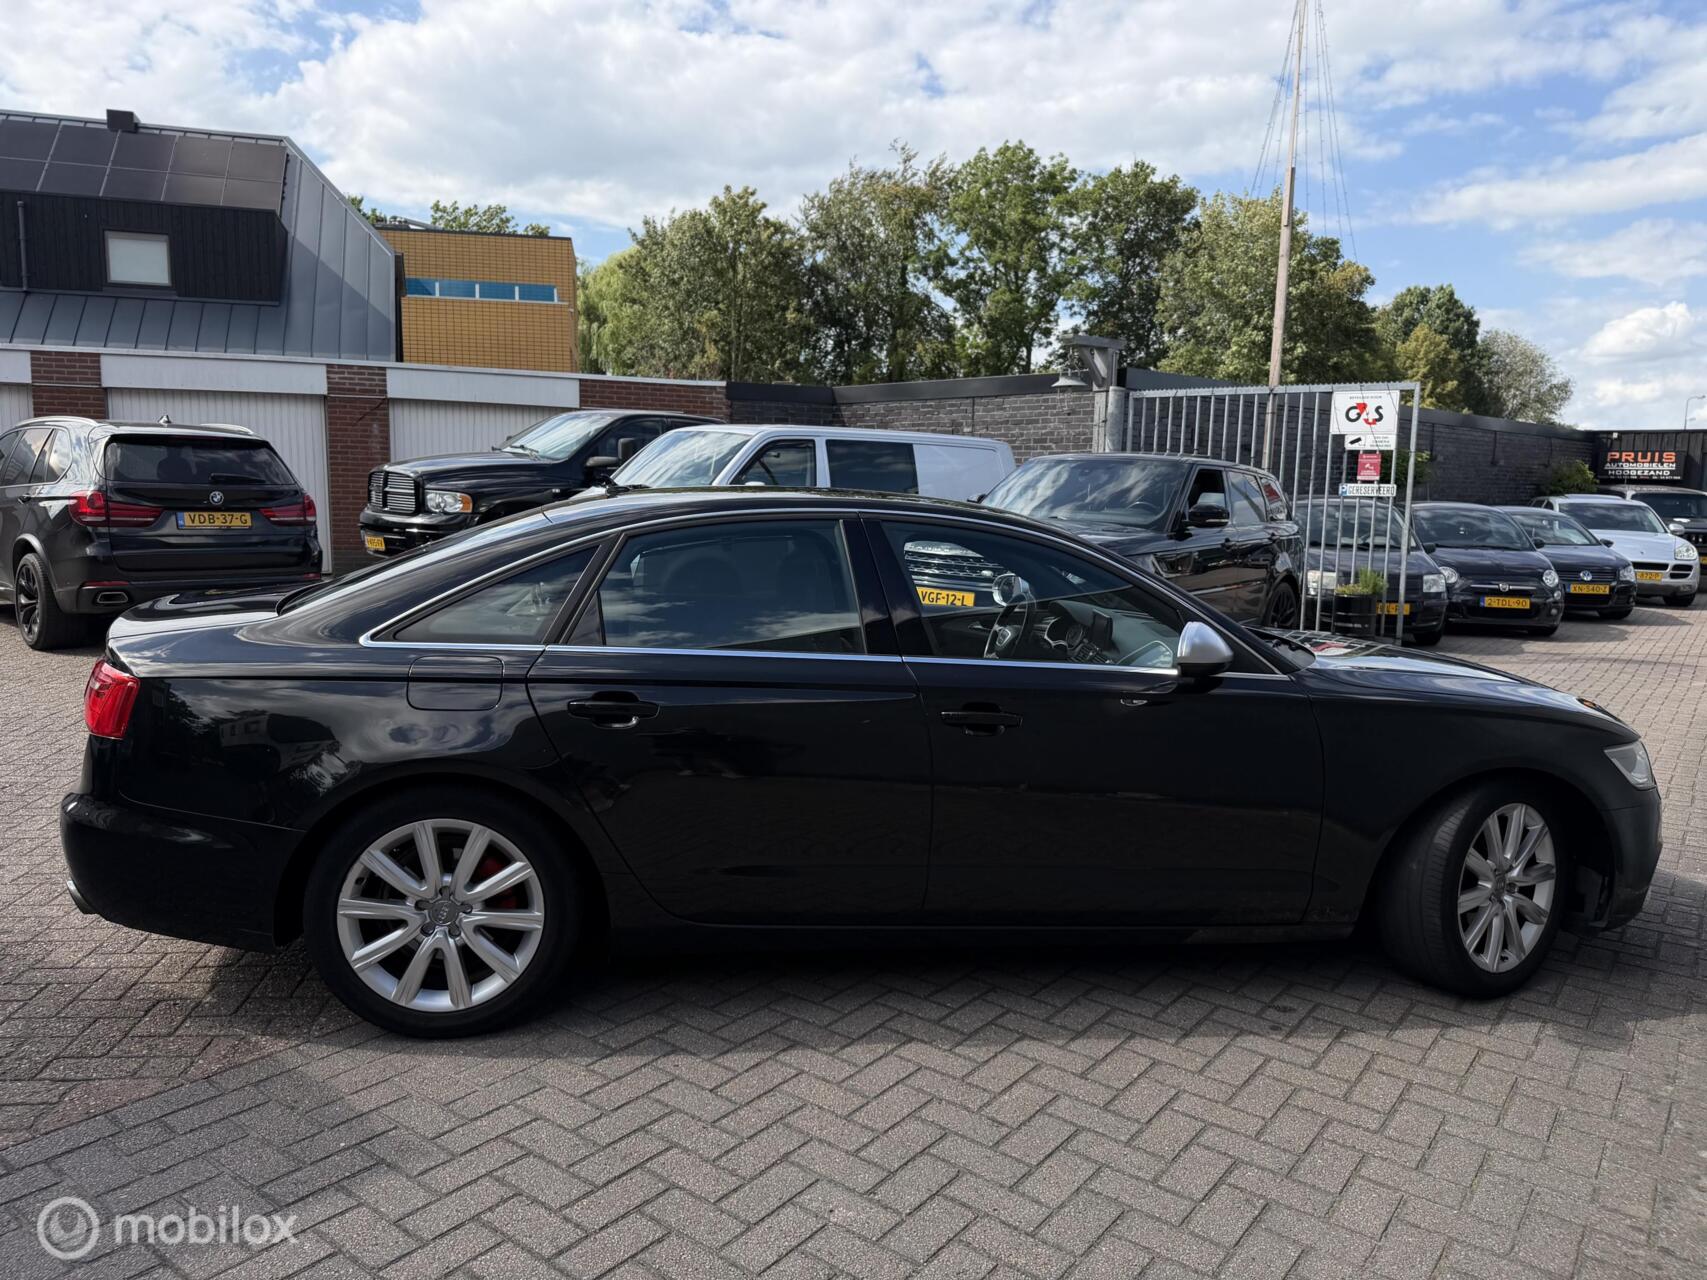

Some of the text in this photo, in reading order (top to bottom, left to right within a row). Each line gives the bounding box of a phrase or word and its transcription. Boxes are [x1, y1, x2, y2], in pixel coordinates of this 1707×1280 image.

[1345, 402, 1384, 425] G4S
[1607, 452, 1676, 462] PRUIS
[1348, 485, 1395, 495] GERESERVEERD
[188, 513, 248, 525] VDB-37-G
[921, 590, 967, 607] VGF-12-L
[1487, 598, 1527, 608] 2-TDL-90
